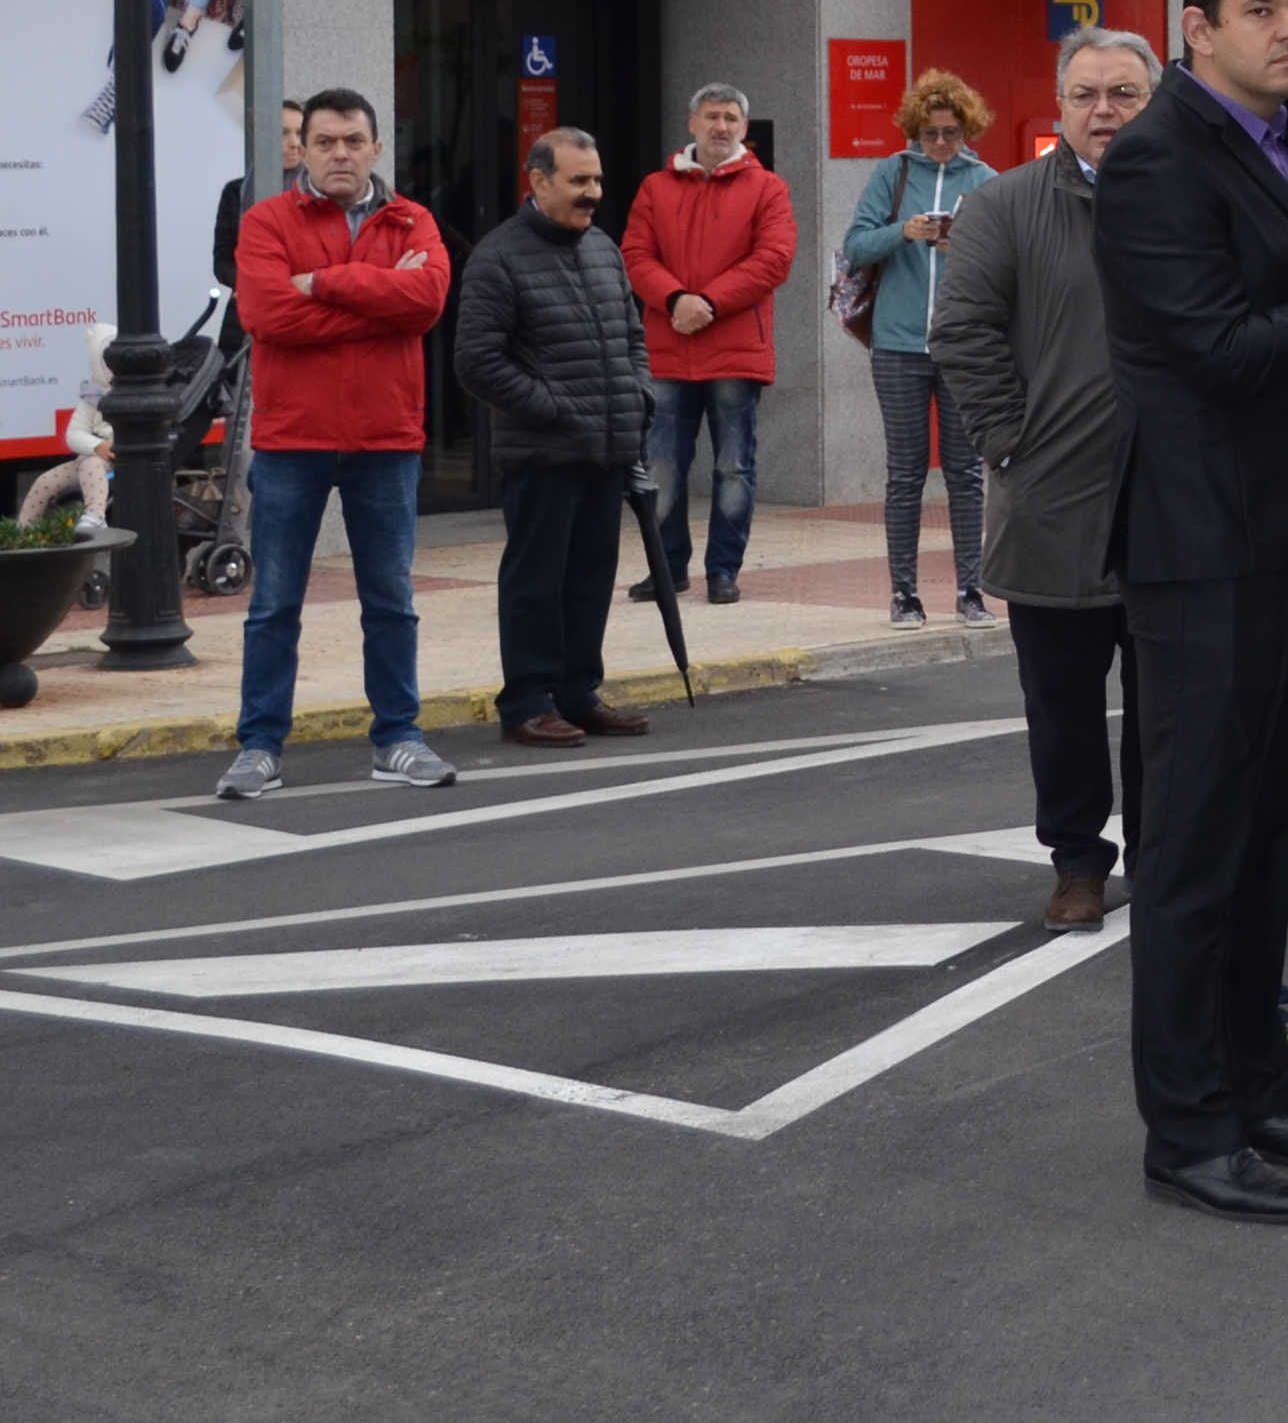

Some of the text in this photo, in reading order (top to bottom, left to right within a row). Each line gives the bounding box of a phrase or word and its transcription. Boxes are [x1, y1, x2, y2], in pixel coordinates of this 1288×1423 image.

[847, 55, 889, 67] OROPESA
[850, 69, 886, 81] DE MAR
[0, 307, 97, 328] SmartBank
